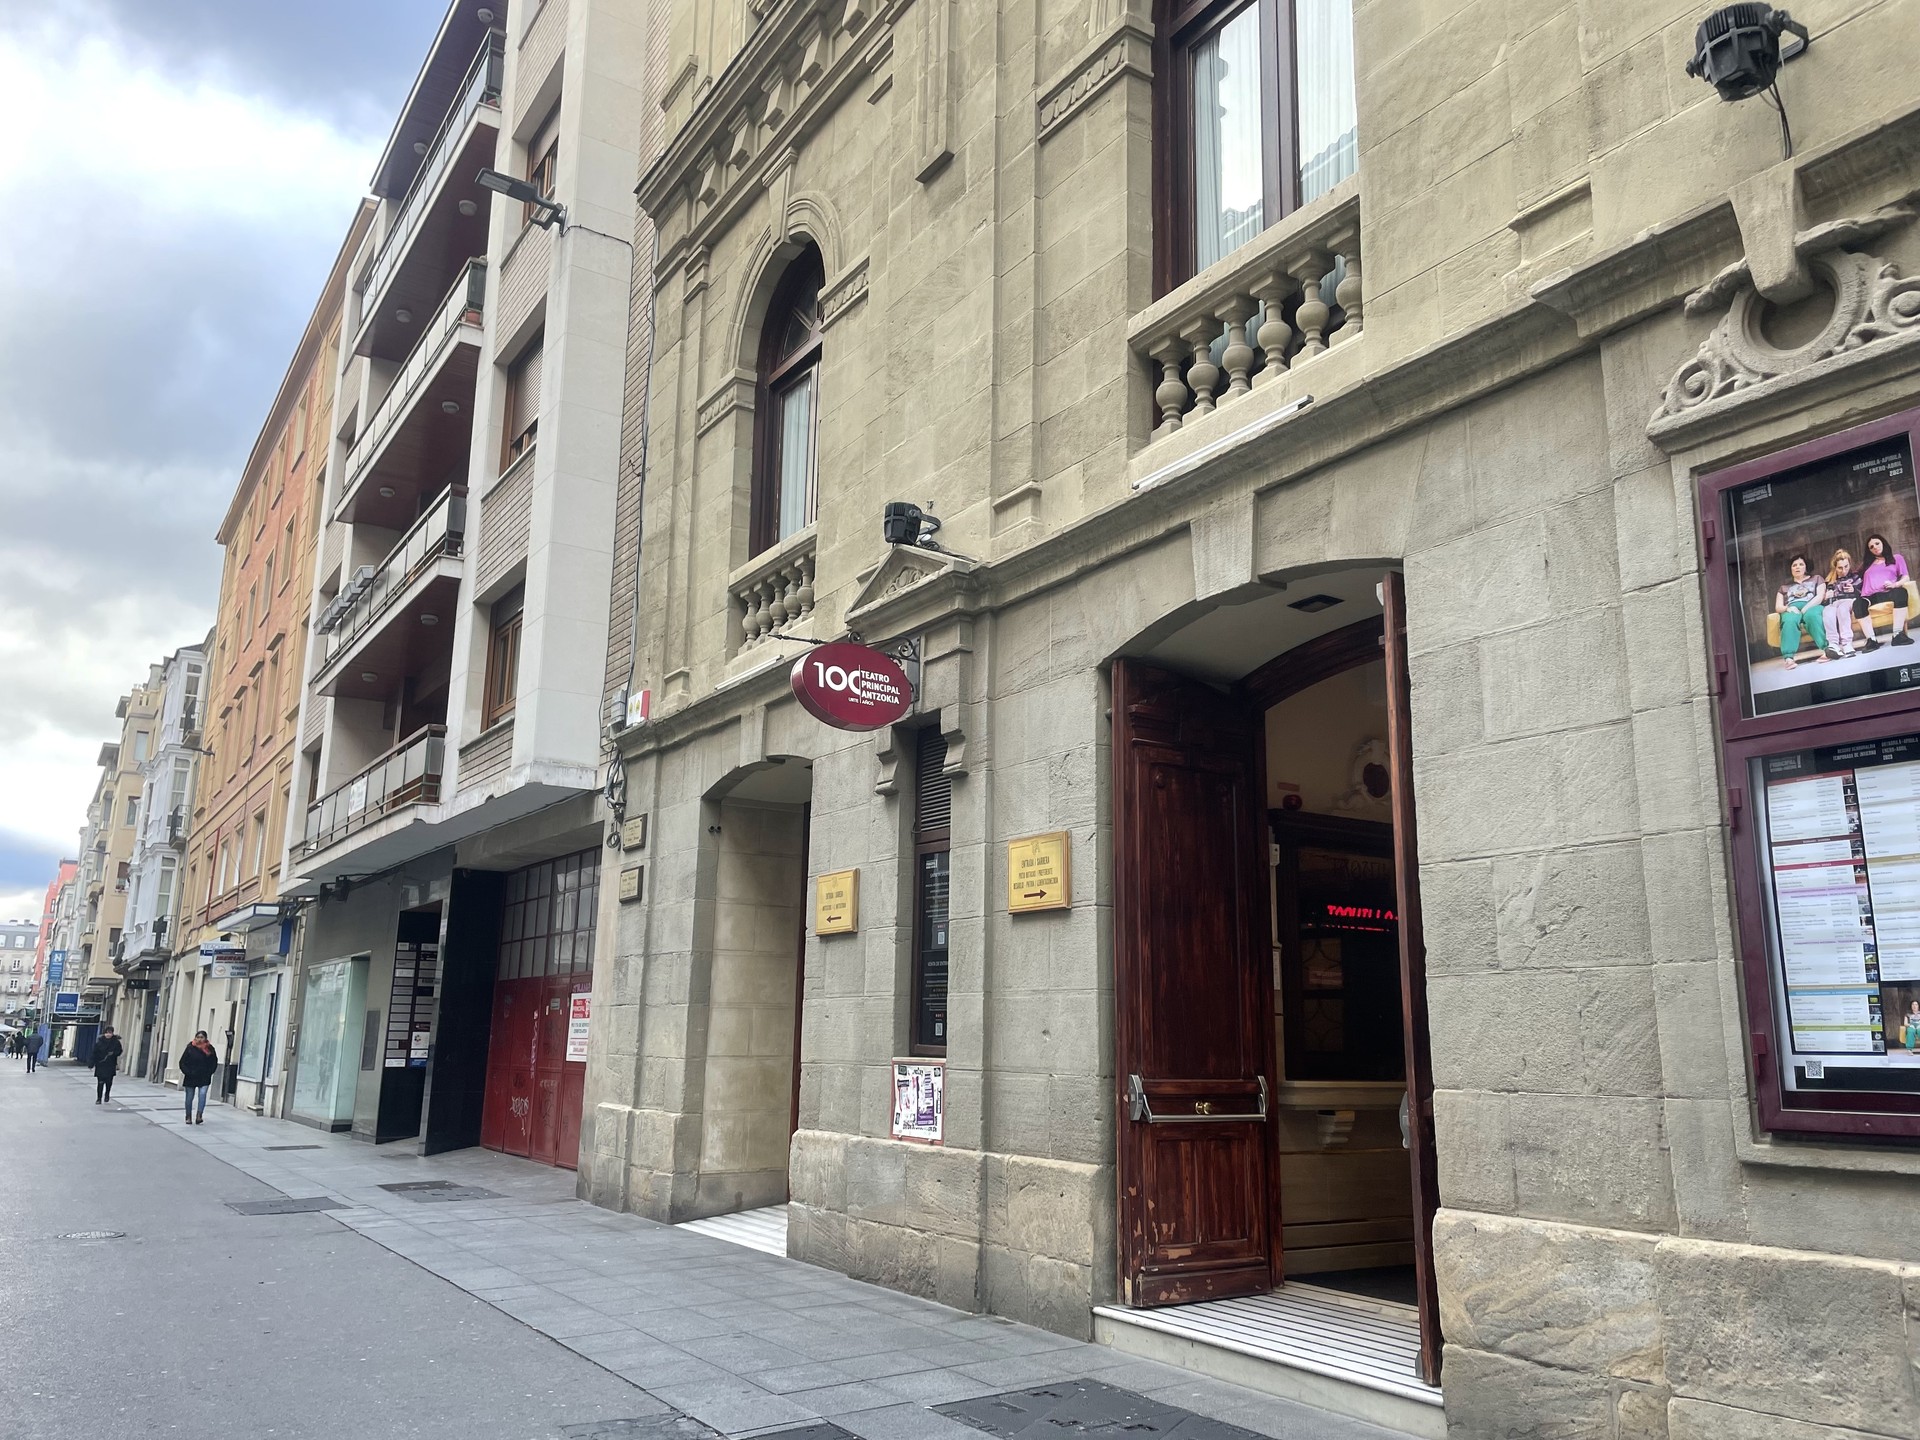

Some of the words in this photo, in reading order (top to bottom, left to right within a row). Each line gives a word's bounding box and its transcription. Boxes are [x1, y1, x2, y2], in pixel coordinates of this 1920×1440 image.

[1889, 468, 1903, 477] 2023
[860, 670, 890, 683] TEATRO
[861, 680, 901, 695] PRINCIPAL
[861, 690, 900, 705] ANTZOKIA
